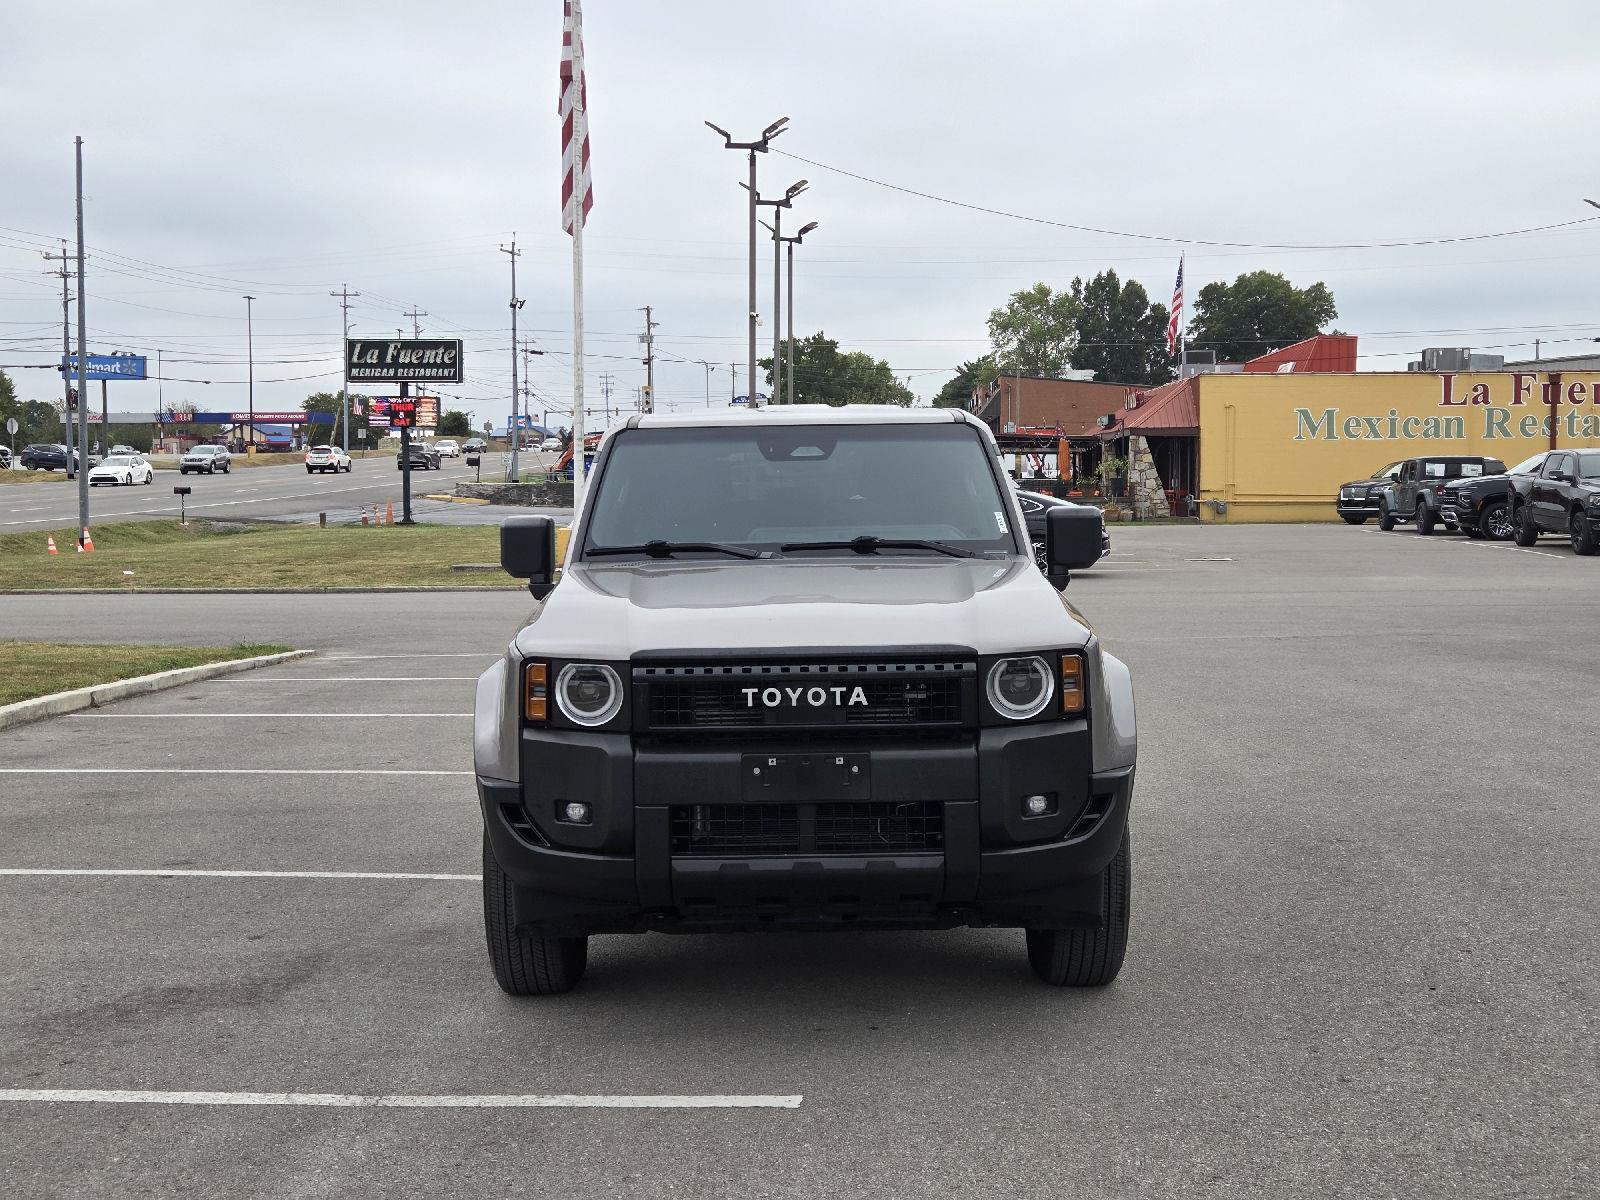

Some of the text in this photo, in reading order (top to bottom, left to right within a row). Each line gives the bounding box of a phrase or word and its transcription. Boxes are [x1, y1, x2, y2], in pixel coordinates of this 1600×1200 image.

[351, 342, 457, 364] La Fuente
[69, 361, 121, 374] Wlmart
[350, 368, 456, 377] MEXICAN RESTAURANT
[1438, 373, 1492, 407] La
[390, 402, 415, 411] THUR
[1293, 406, 1600, 441] Mexican Resta
[742, 686, 869, 707] TOYOTA
